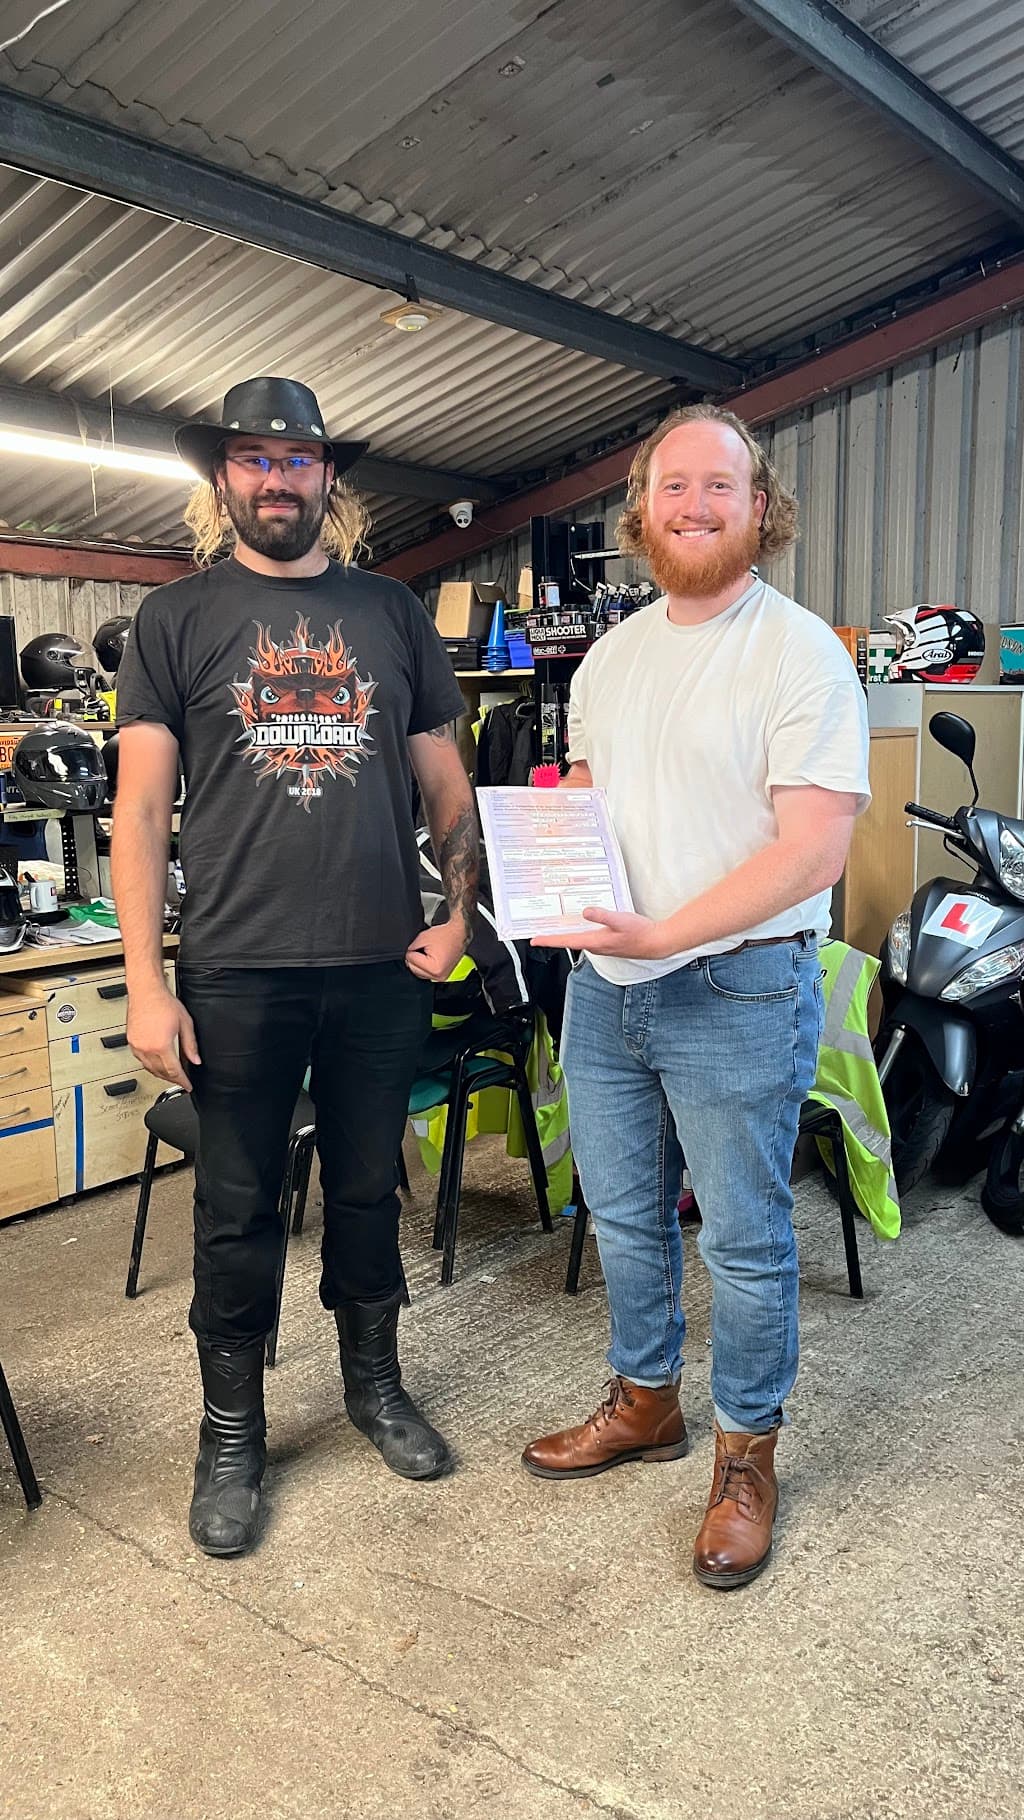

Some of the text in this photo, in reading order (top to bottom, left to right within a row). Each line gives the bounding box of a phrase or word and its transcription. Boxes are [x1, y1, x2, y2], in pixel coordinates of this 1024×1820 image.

[546, 625, 586, 636] SHOOTER
[256, 725, 357, 747] DOWNLOAD
[288, 787, 300, 796] UK
[941, 903, 969, 934] L
